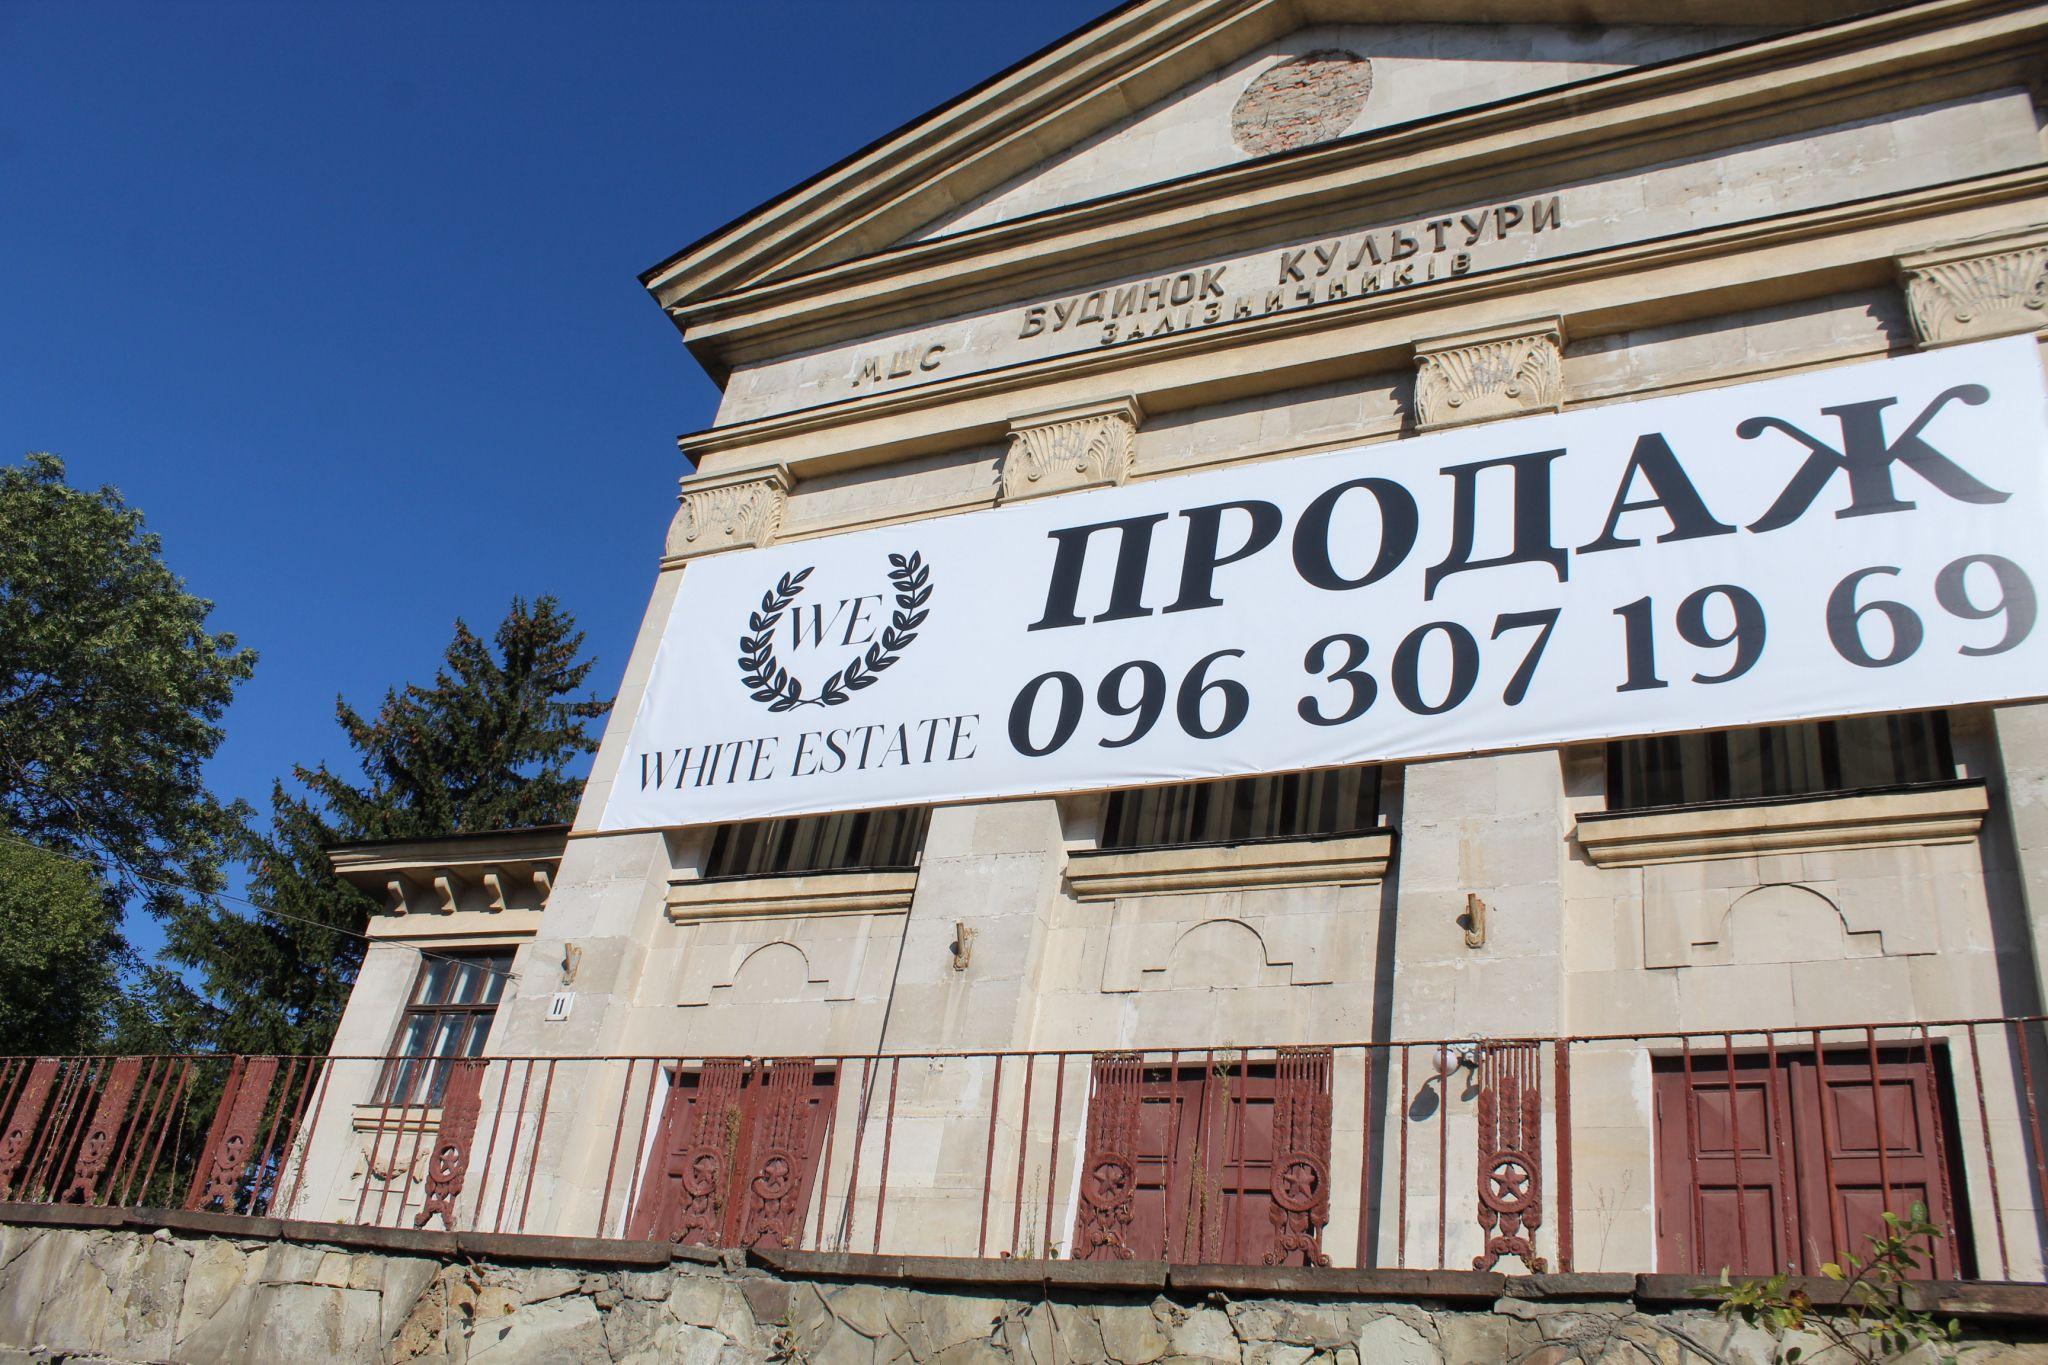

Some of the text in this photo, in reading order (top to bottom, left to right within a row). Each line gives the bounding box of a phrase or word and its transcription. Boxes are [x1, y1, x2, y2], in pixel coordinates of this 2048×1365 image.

[1018, 195, 1561, 339] БУДИНОК КУЛЬТУРИ
[1100, 252, 1472, 345] ЗАЛІЗНИЧНИКІВ
[1028, 384, 2012, 632] ПРОДАЖ
[790, 594, 883, 652] WE
[1008, 553, 2038, 758] 096 307 19 69
[640, 714, 980, 792] WHITE ESTATE
